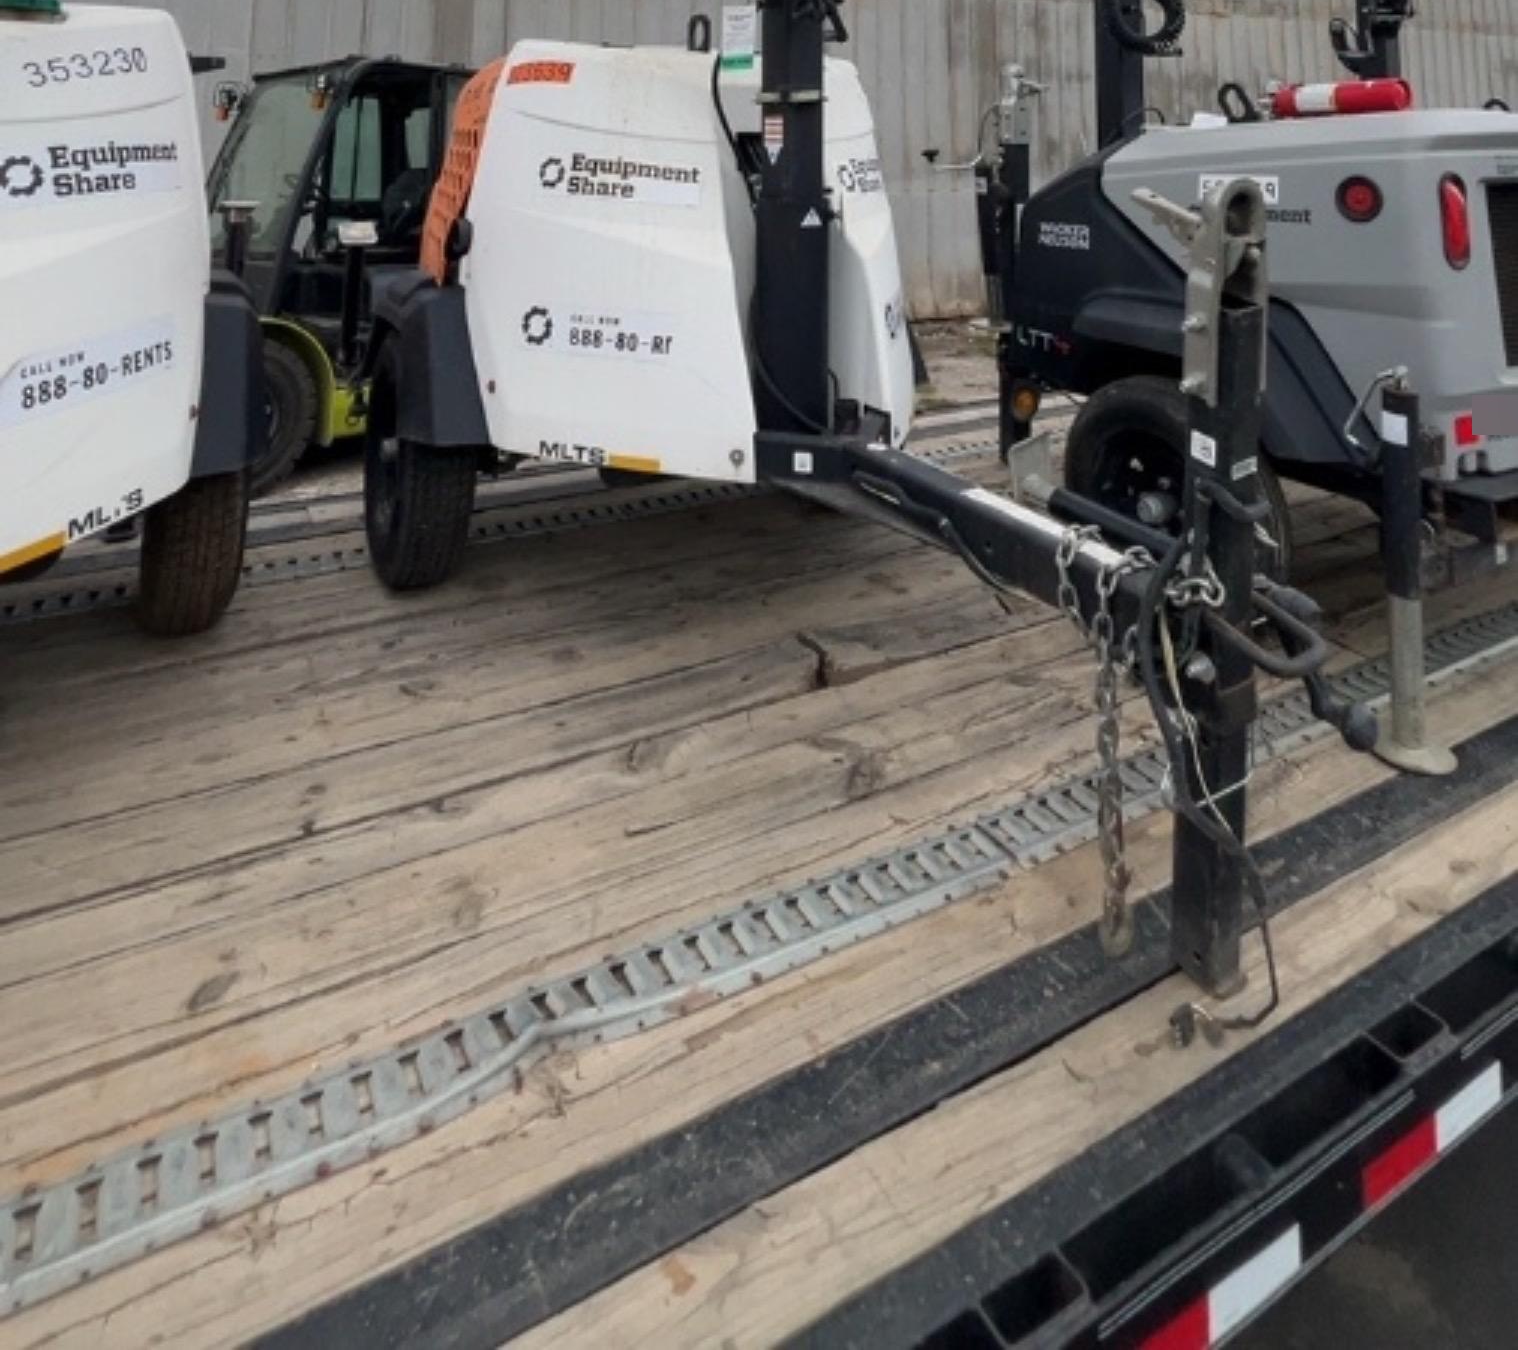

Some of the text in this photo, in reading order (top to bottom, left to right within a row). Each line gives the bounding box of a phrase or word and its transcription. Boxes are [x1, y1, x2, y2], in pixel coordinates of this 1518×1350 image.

[22, 47, 148, 87] 353230
[48, 140, 177, 171] Equipment
[569, 152, 701, 184] Equipment
[52, 172, 137, 198] Share
[566, 175, 635, 199] Share
[21, 341, 172, 410] 888-80-RENTS
